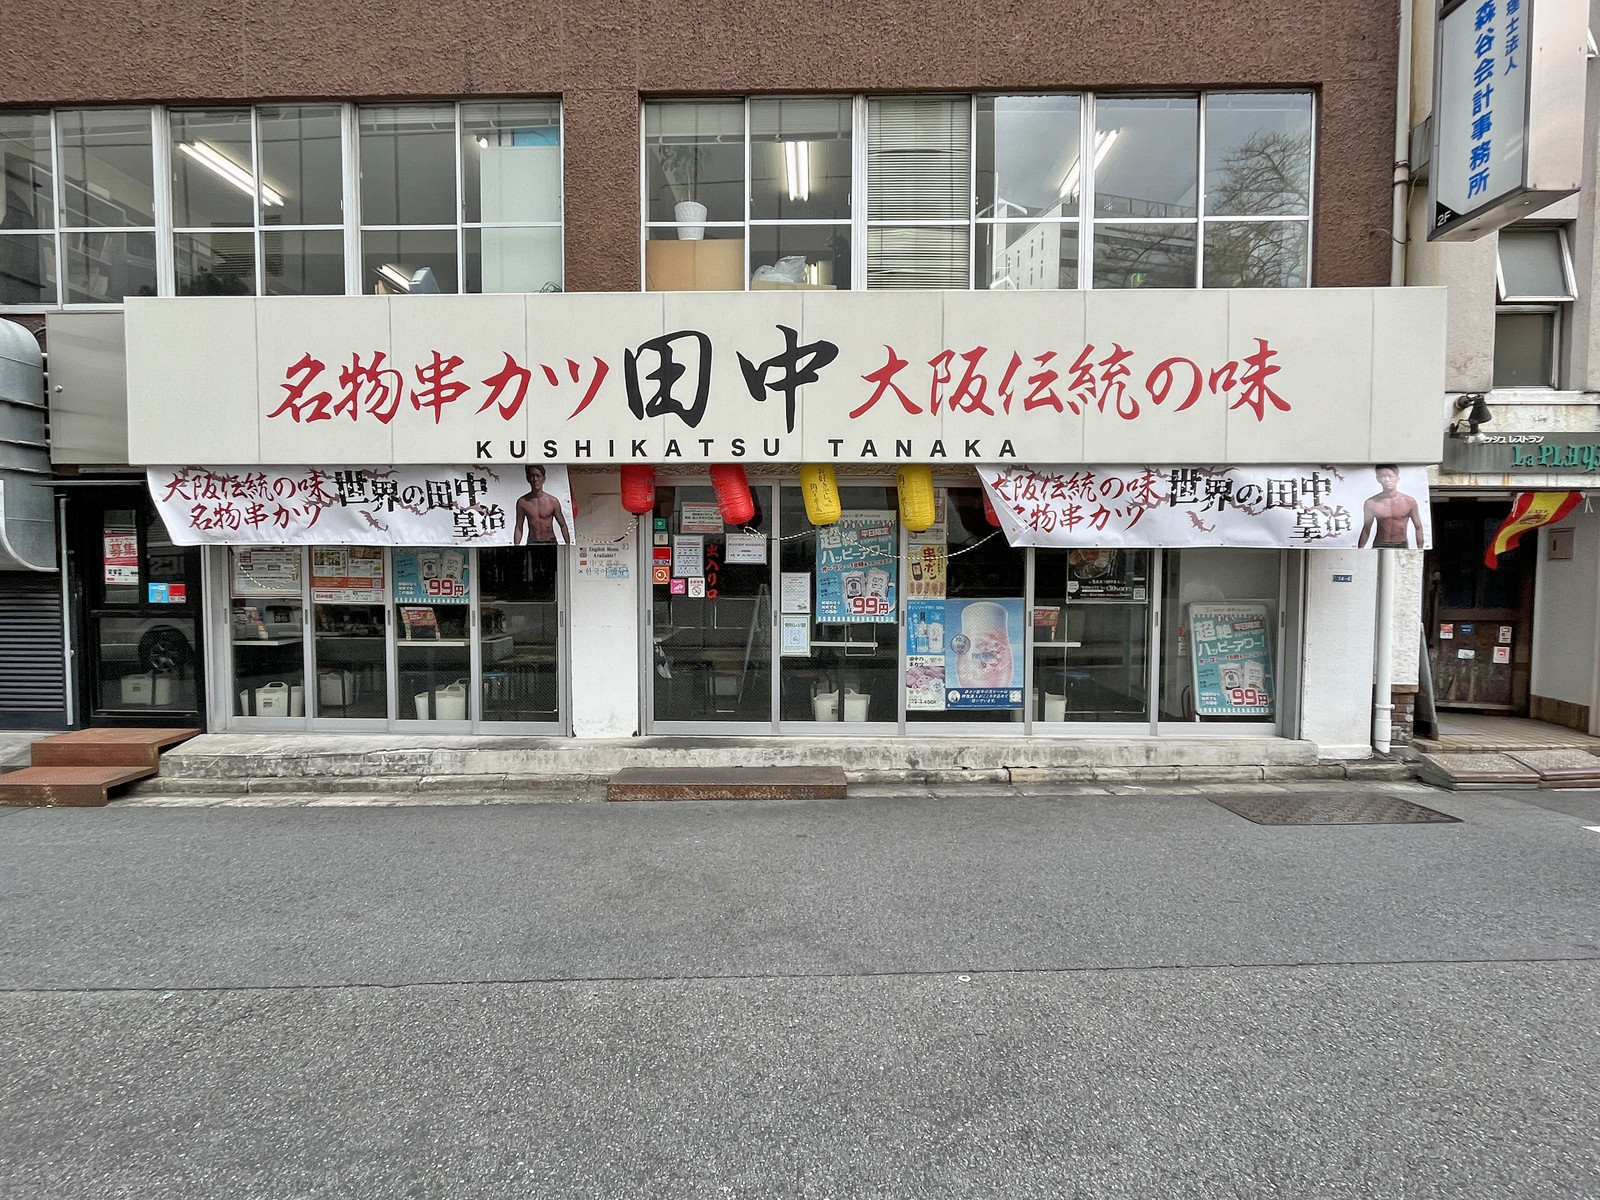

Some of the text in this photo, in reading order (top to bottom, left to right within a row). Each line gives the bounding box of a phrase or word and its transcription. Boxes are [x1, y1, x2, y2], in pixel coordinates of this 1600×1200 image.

[1467, 0, 1496, 199] 森谷会計事務所
[1437, 211, 1452, 227] 2F
[266, 324, 1292, 434] 名物串カツ 田中 大阪伝統の味
[476, 438, 1017, 459] KUSHIKATSU TANAKA
[1509, 435, 1544, 443] レストラン
[1513, 444, 1535, 466] La
[162, 471, 333, 502] 大阪伝統の味
[334, 470, 488, 512] 世界の田中
[991, 470, 1160, 503] 大阪伝統の味
[1168, 469, 1332, 512] 世界の田中
[452, 504, 506, 538] 皇治
[1291, 505, 1352, 541] 皇治
[853, 597, 889, 615] 99円
[1232, 689, 1268, 706] 99円
